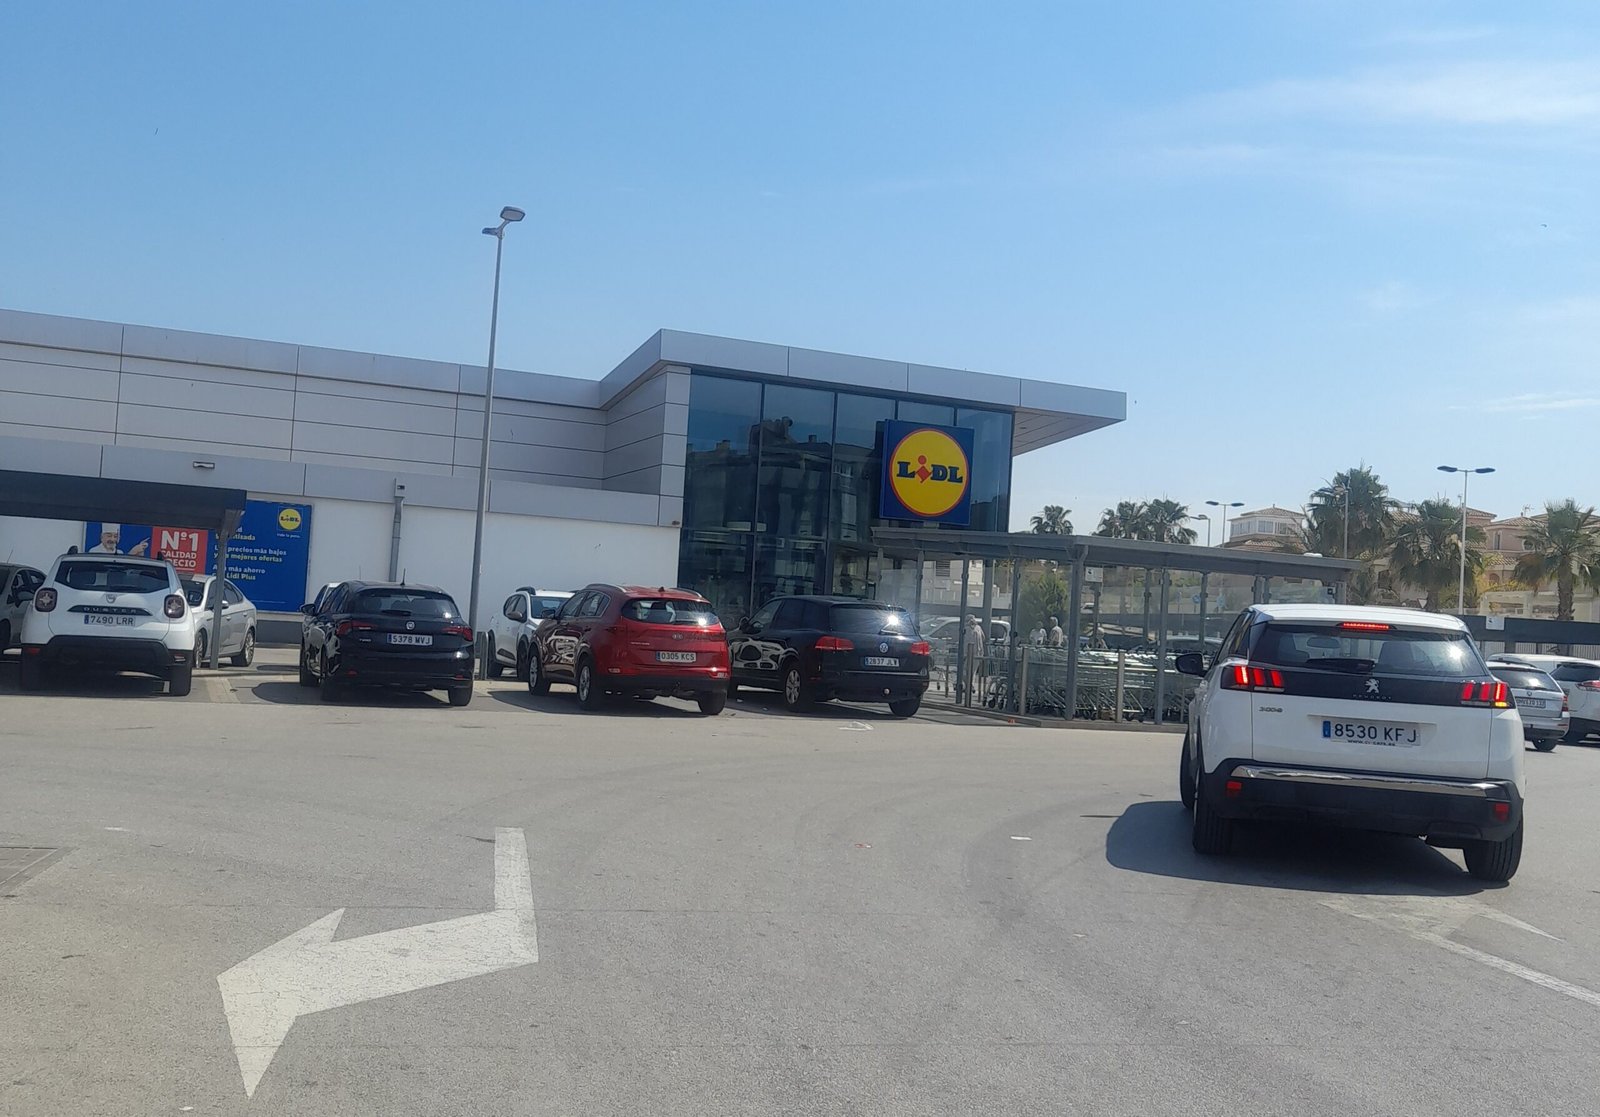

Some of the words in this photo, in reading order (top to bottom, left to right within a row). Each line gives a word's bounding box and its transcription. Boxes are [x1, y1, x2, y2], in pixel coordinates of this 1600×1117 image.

[230, 553, 257, 561] mejores
[165, 559, 196, 568] ECIO
[243, 566, 266, 574] ahorro
[90, 615, 114, 624] 7490
[116, 617, 134, 625] LRR
[392, 635, 412, 644] 5378
[661, 652, 679, 660] 0305
[681, 653, 695, 661] KCS
[1334, 723, 1377, 740] 8530
[1384, 727, 1417, 743] KFJ
